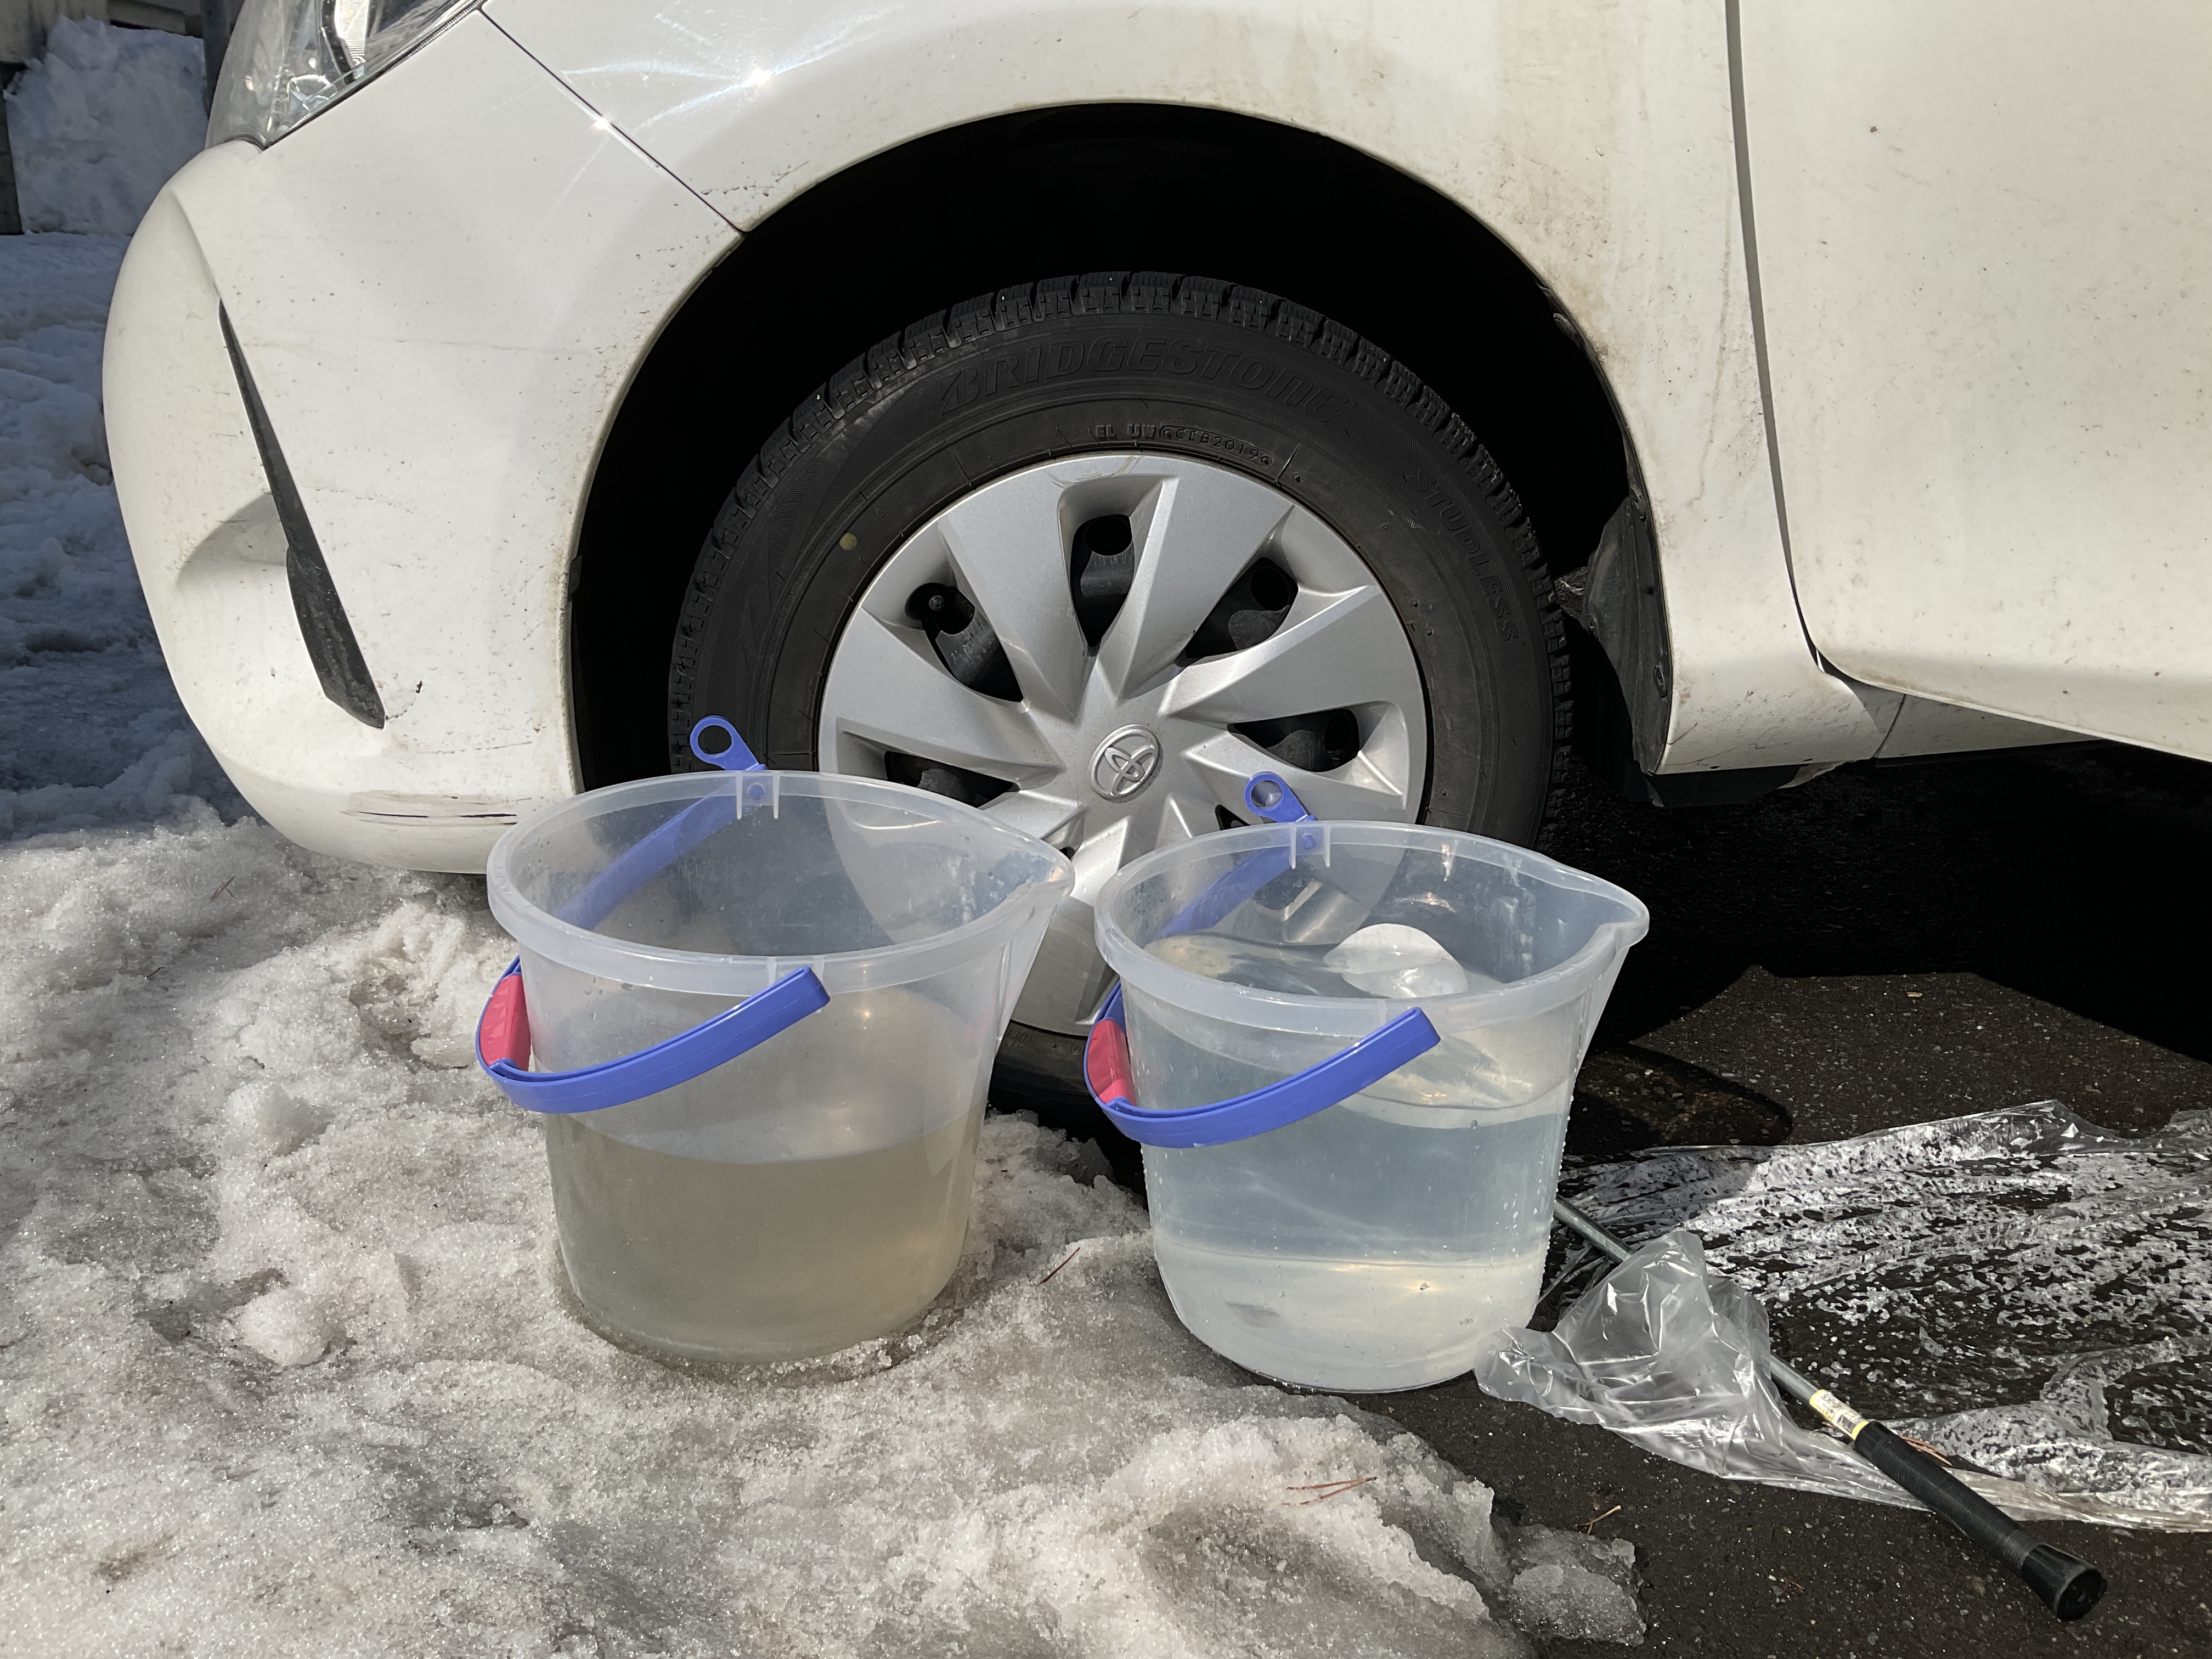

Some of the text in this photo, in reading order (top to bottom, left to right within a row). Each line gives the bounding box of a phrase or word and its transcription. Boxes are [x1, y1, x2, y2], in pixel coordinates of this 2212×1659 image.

[940, 336, 1351, 423] BRIDGESTONE
[1096, 425, 1116, 438] EL
[1415, 471, 1518, 641] STUDLESS
